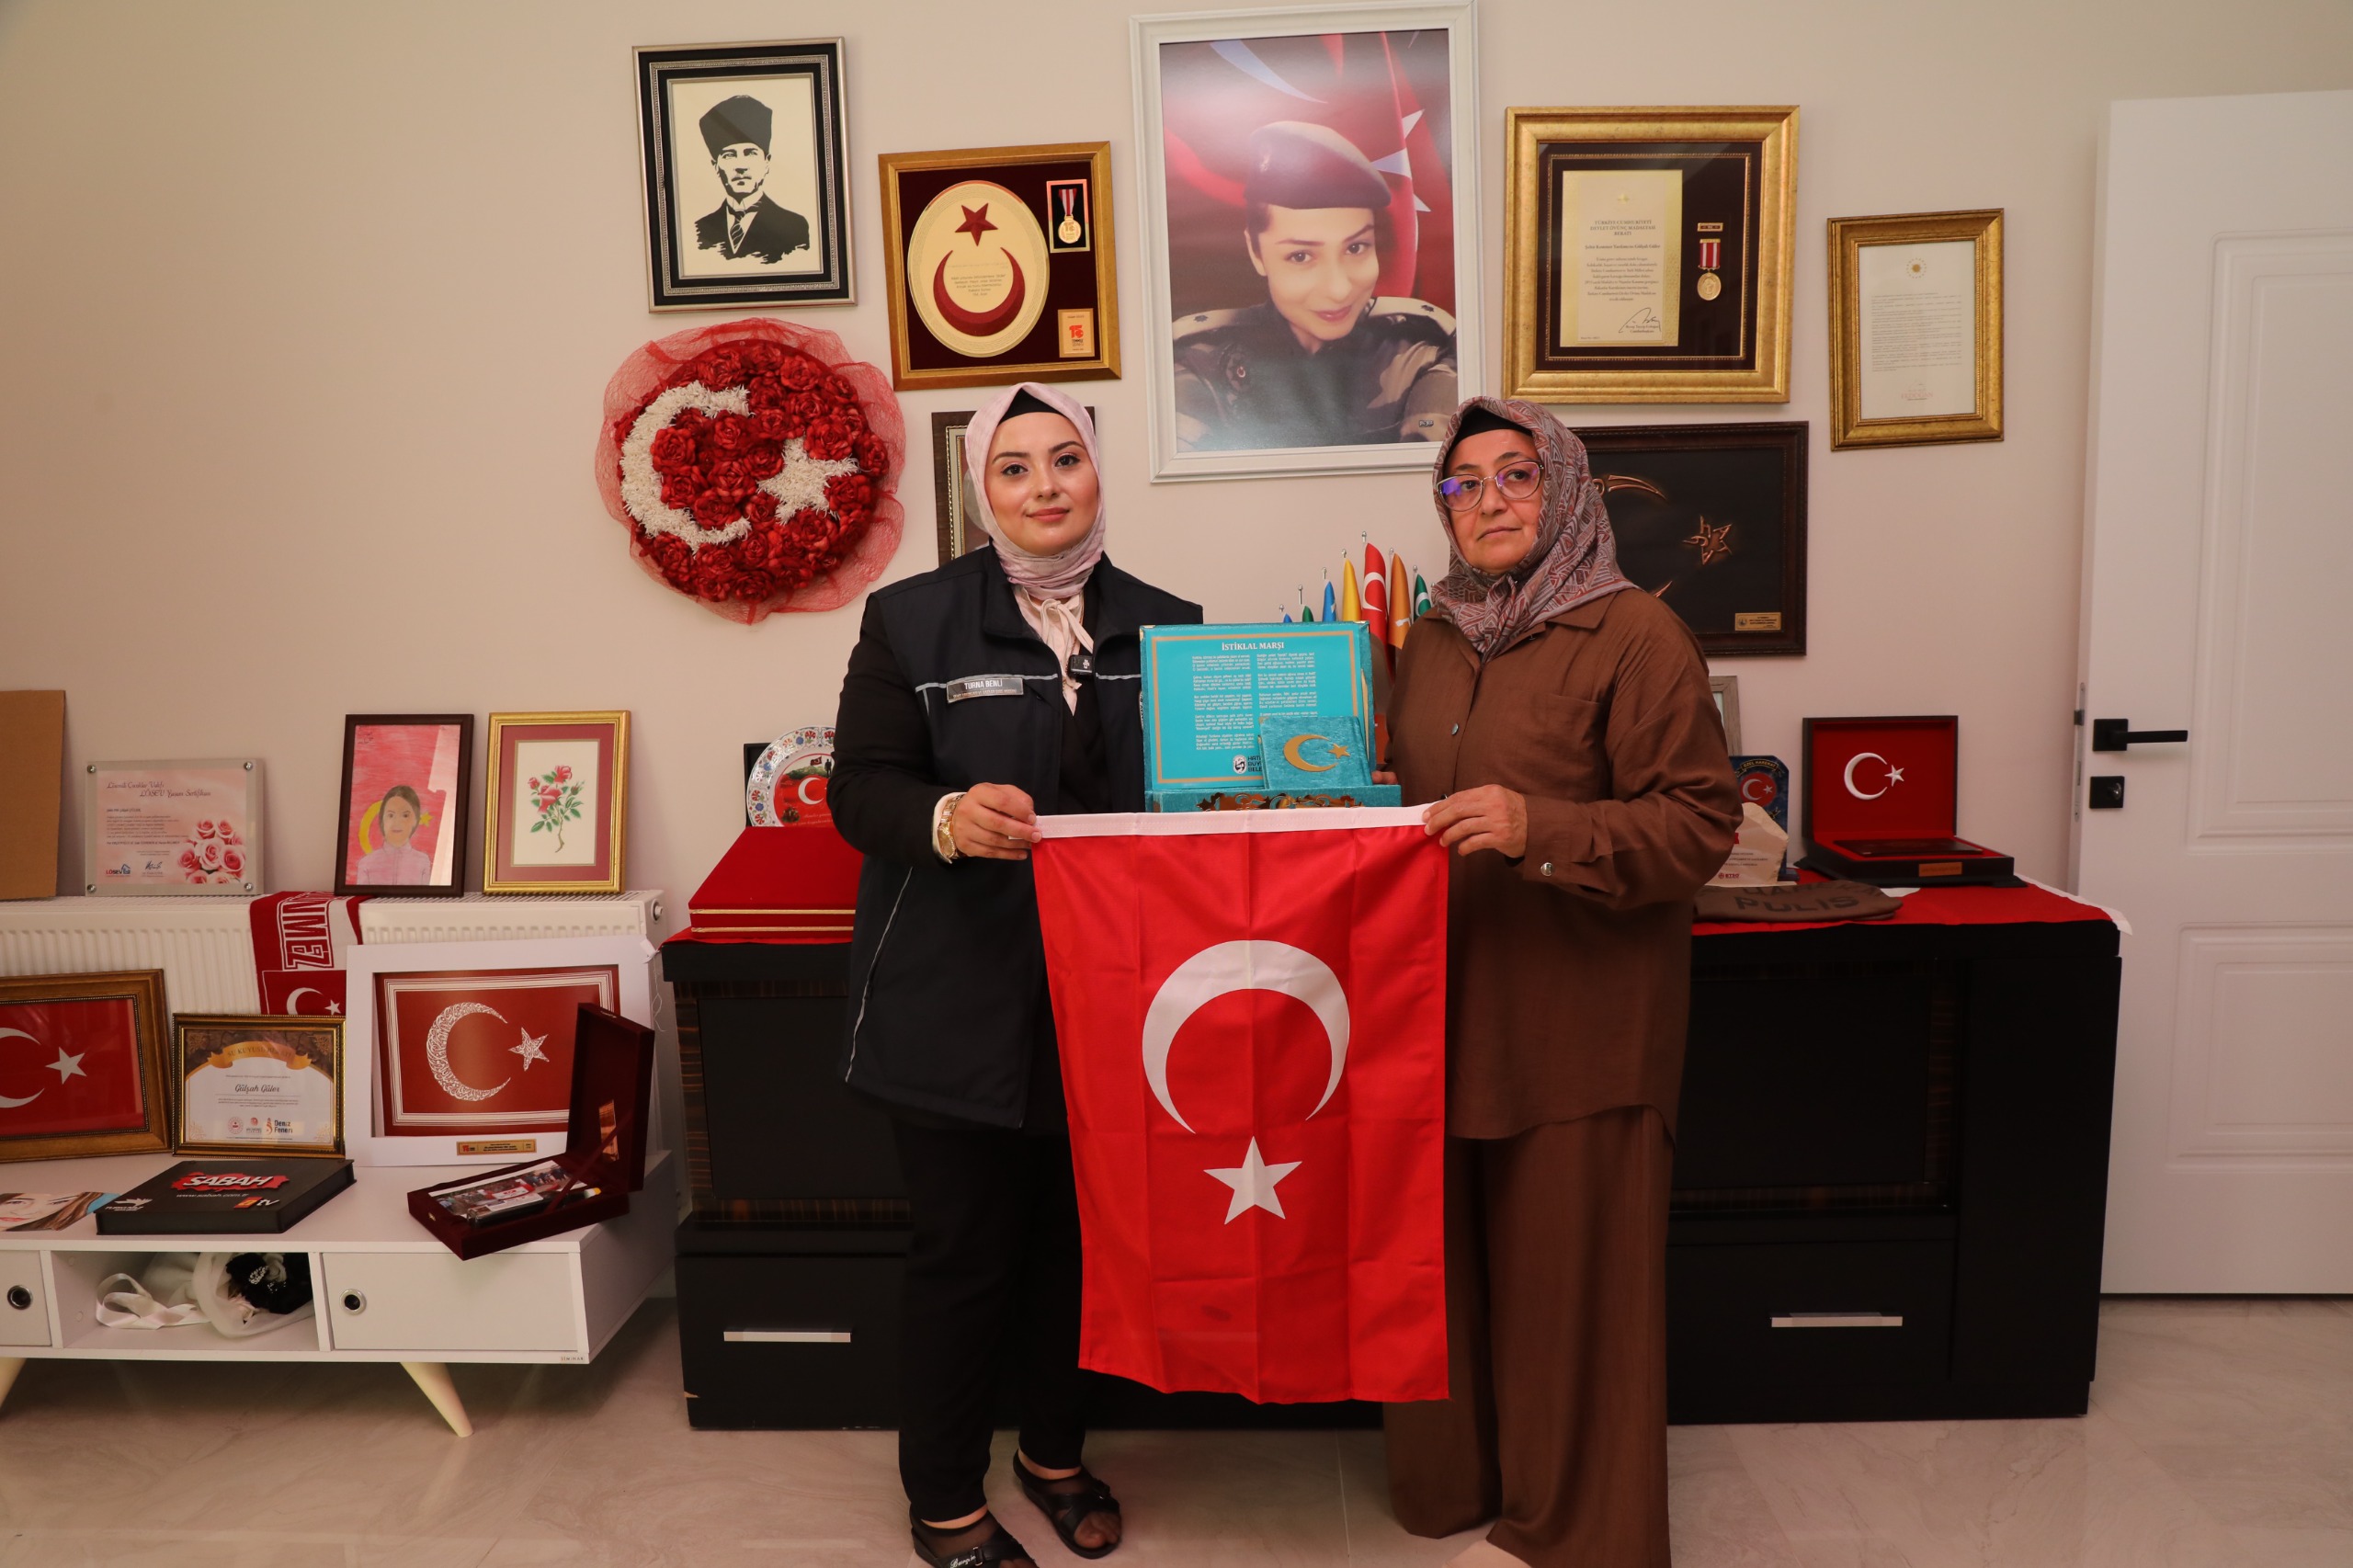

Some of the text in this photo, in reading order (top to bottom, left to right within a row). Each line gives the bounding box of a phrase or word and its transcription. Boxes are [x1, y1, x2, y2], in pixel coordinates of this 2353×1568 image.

[1222, 642, 1285, 651] İSTİKLAL MARŞI
[964, 681, 984, 690] TURNA
[234, 1084, 280, 1094] Gülşah Güler
[182, 1176, 274, 1187] SABAH
